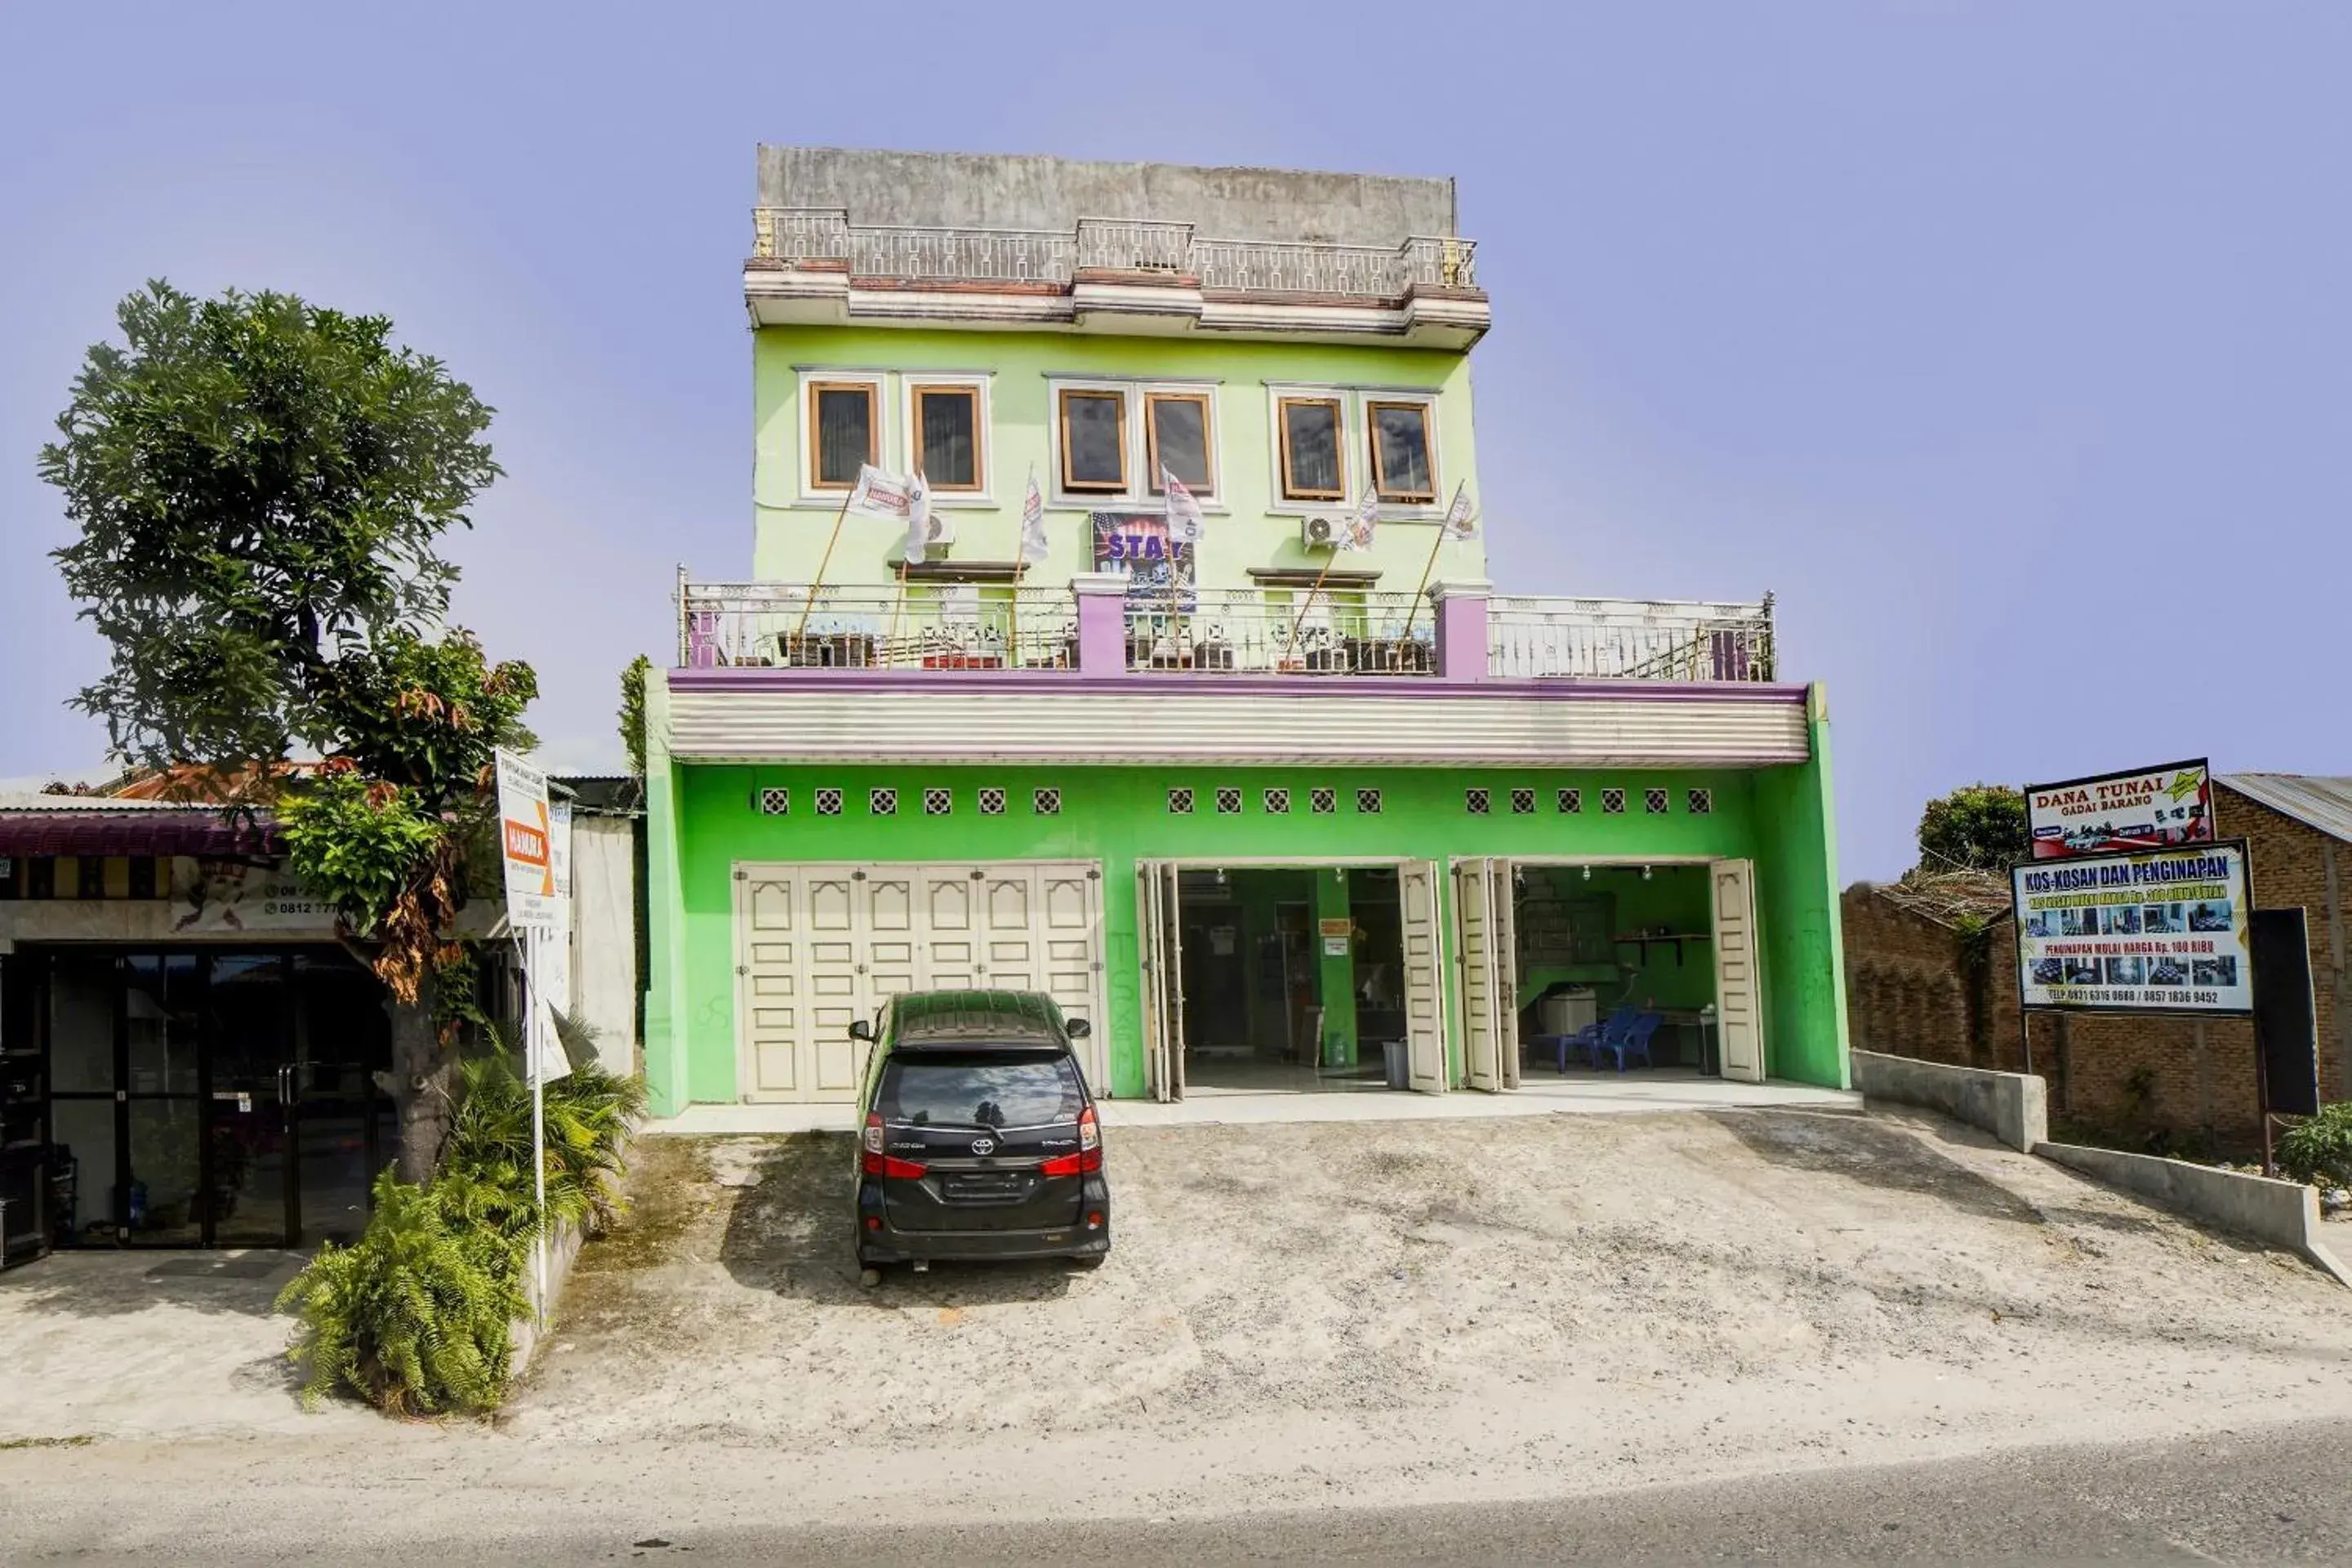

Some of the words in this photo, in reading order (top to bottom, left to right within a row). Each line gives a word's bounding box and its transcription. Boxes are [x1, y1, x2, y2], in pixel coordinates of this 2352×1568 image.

[2037, 790, 2089, 808] DANA
[2096, 777, 2163, 800] TUNAI
[2061, 803, 2097, 817] GADAI
[2101, 795, 2152, 812] BARANG
[2025, 867, 2097, 891] KOS-KOSAN
[2100, 864, 2130, 884] DAN
[2132, 856, 2228, 883] PENGINAPAN
[280, 902, 311, 914] 0812
[2045, 942, 2093, 956] PENGINAPAN
[2095, 942, 2121, 955] MULAI
[2123, 942, 2153, 954] HARGA
[2155, 942, 2169, 955] Rp.
[2172, 942, 2188, 953] 100
[2191, 941, 2214, 953] RIBU
[2168, 991, 2191, 1003] 1836
[2194, 991, 2218, 1004] 9452
